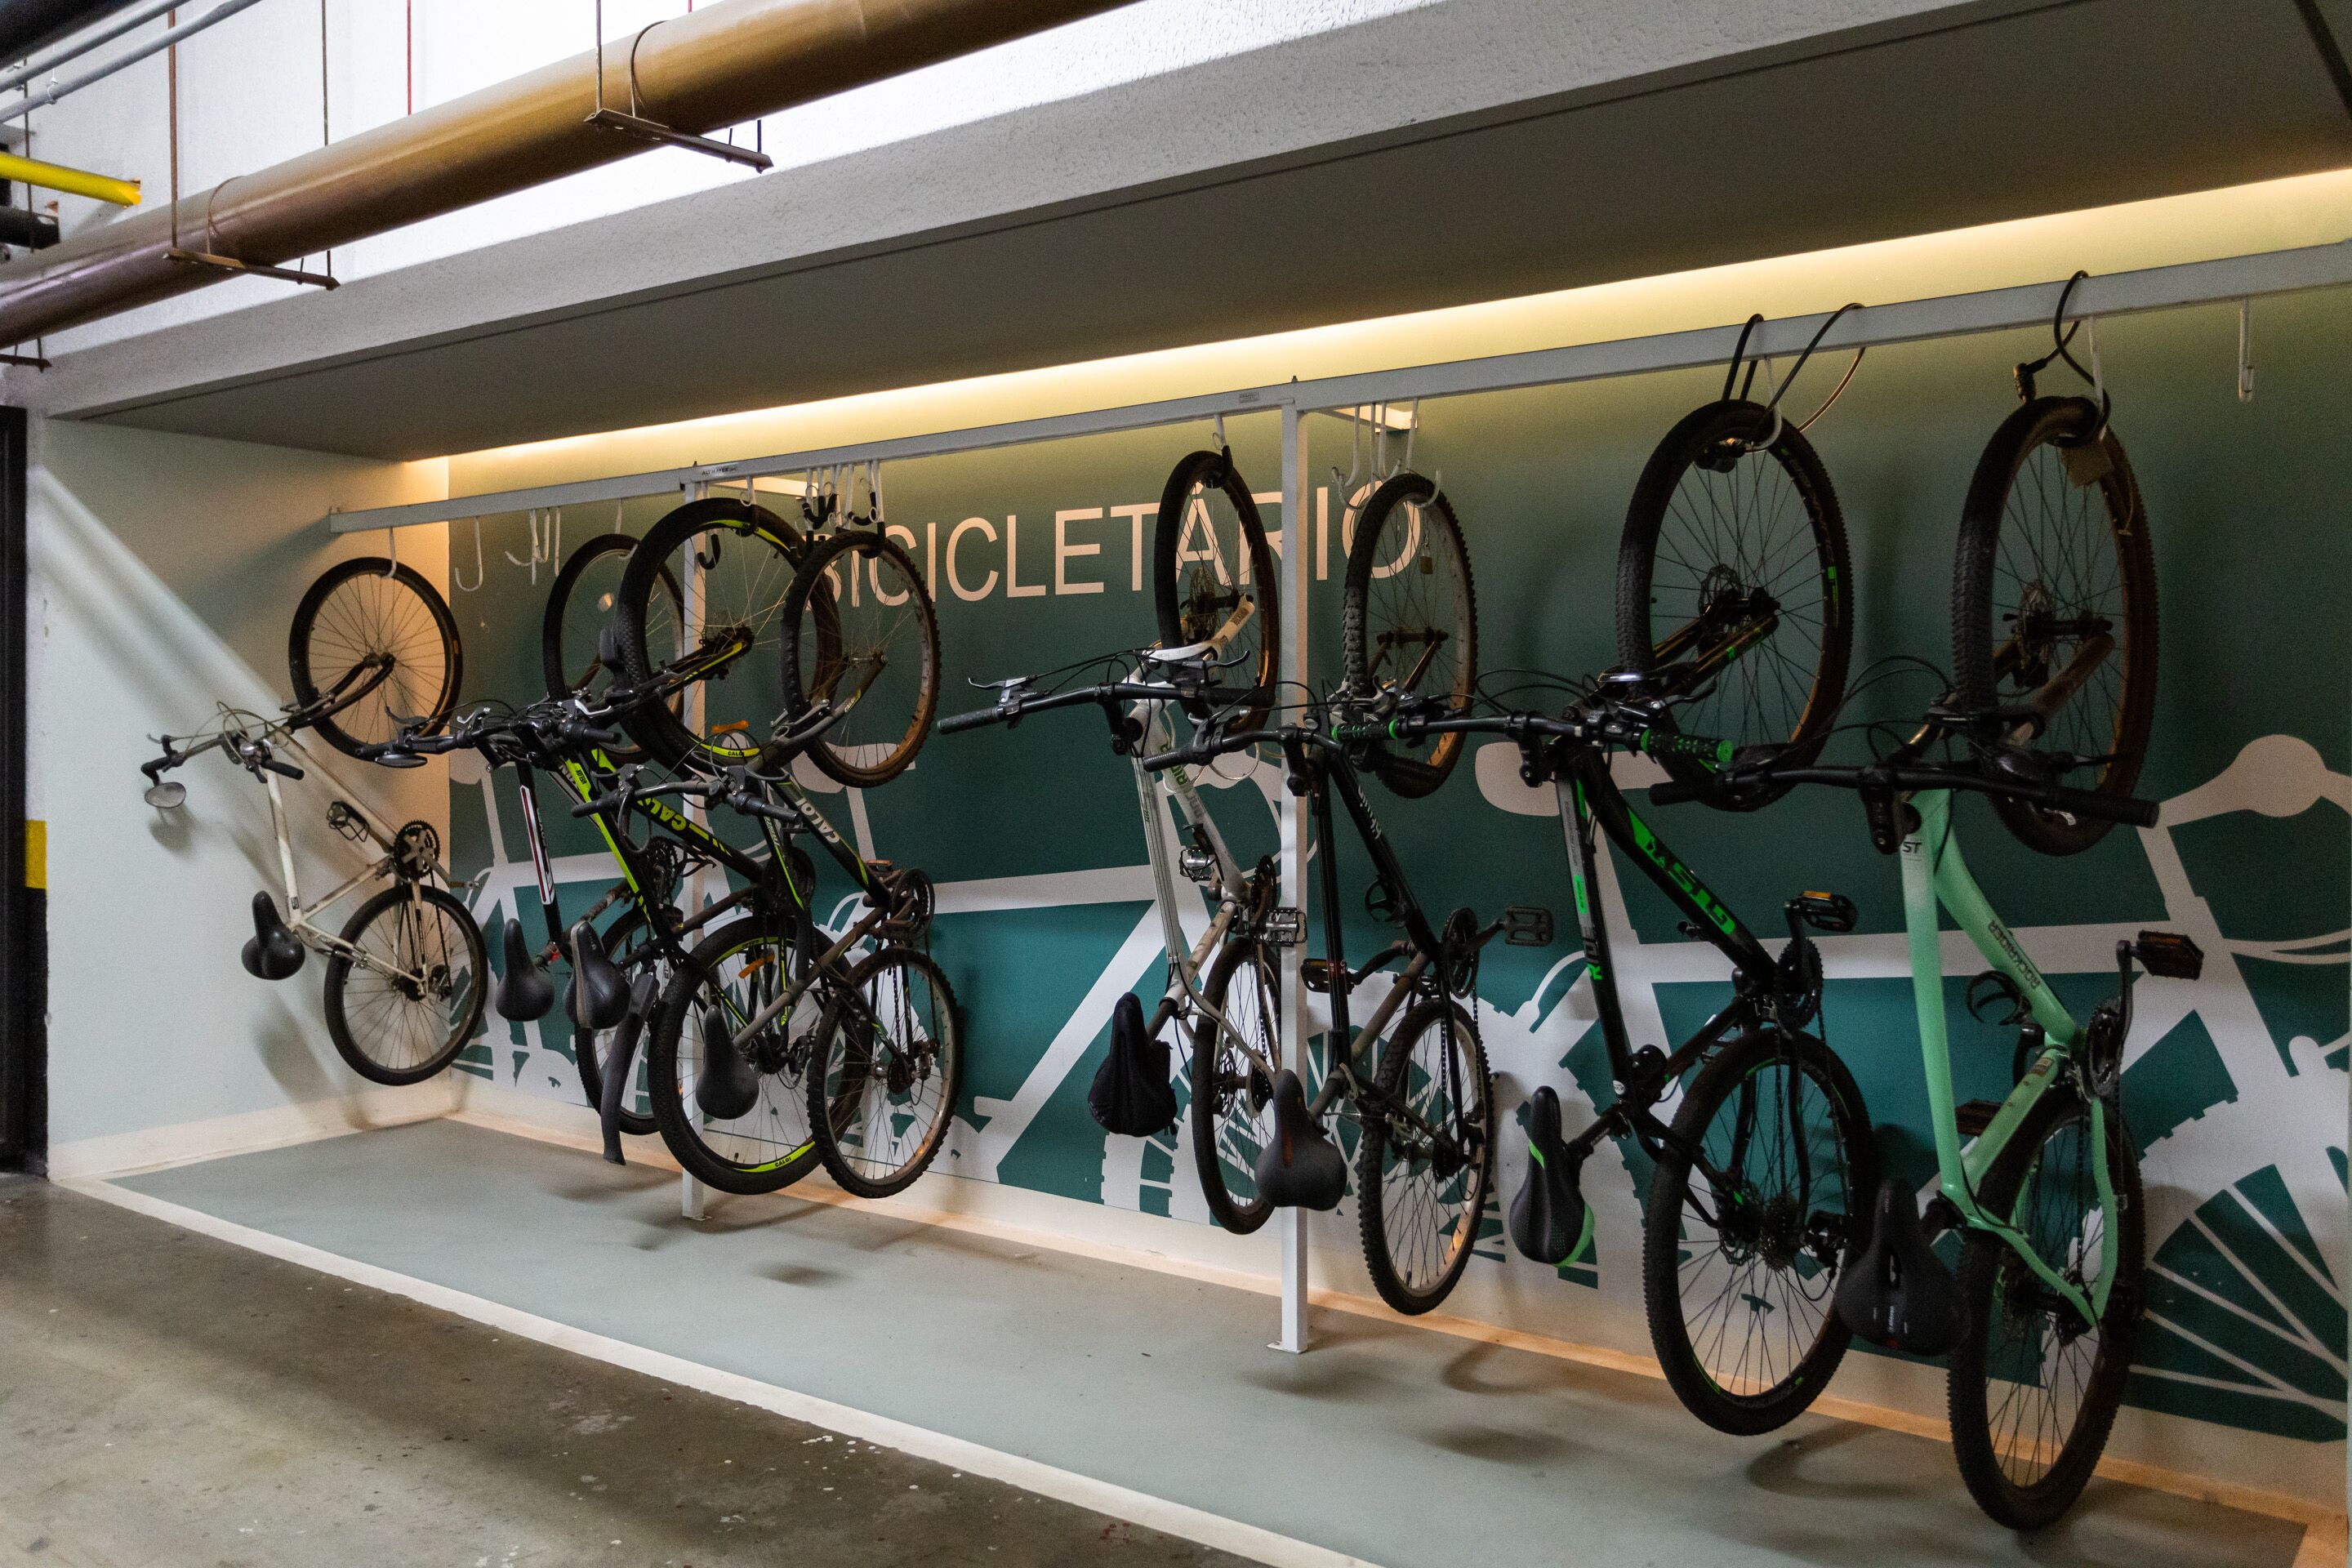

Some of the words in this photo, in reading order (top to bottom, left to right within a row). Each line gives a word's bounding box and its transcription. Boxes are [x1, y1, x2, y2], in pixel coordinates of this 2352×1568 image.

[795, 797, 840, 843] CALOI
[1902, 842, 1922, 853] ST
[1987, 920, 2041, 989] ROCKRIDER
[774, 1156, 792, 1167] CALOI
